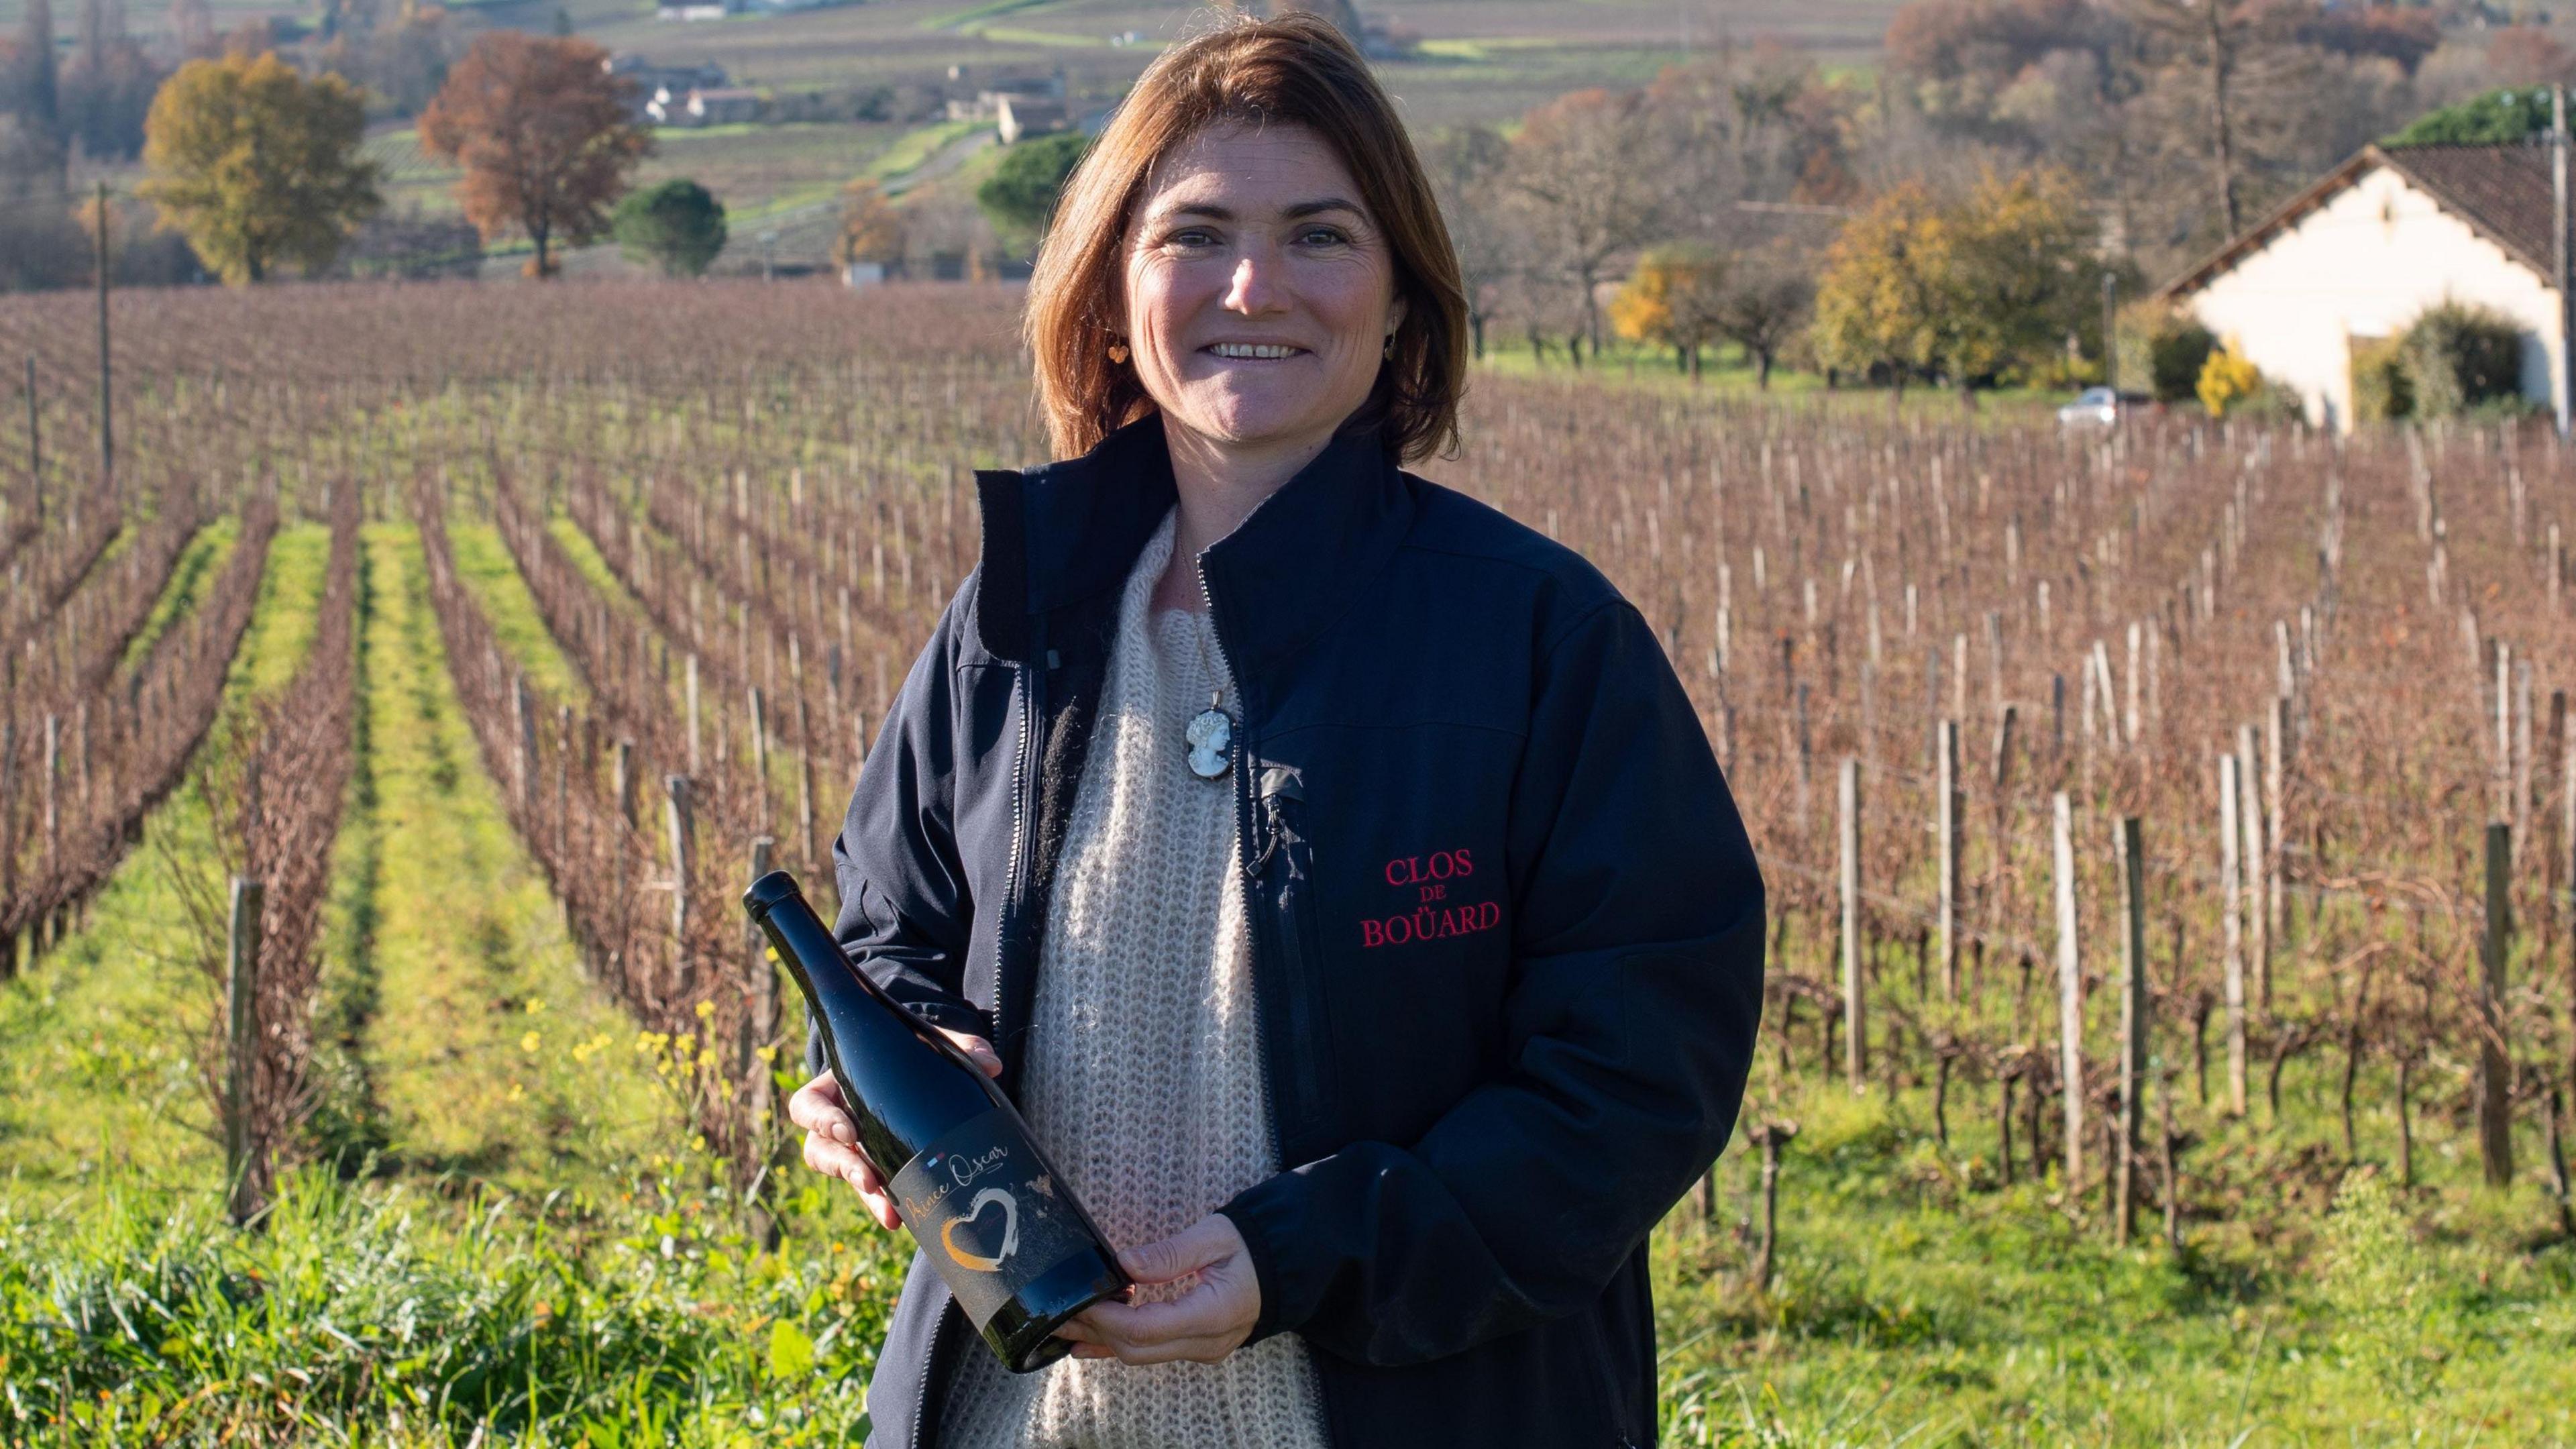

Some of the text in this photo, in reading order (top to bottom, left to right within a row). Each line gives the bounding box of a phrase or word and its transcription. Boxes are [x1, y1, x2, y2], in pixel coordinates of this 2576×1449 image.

[1385, 849, 1473, 885] CLOS
[1419, 884, 1446, 902] DE
[906, 1182, 949, 1228] Prince
[949, 1146, 1008, 1187] Oscar
